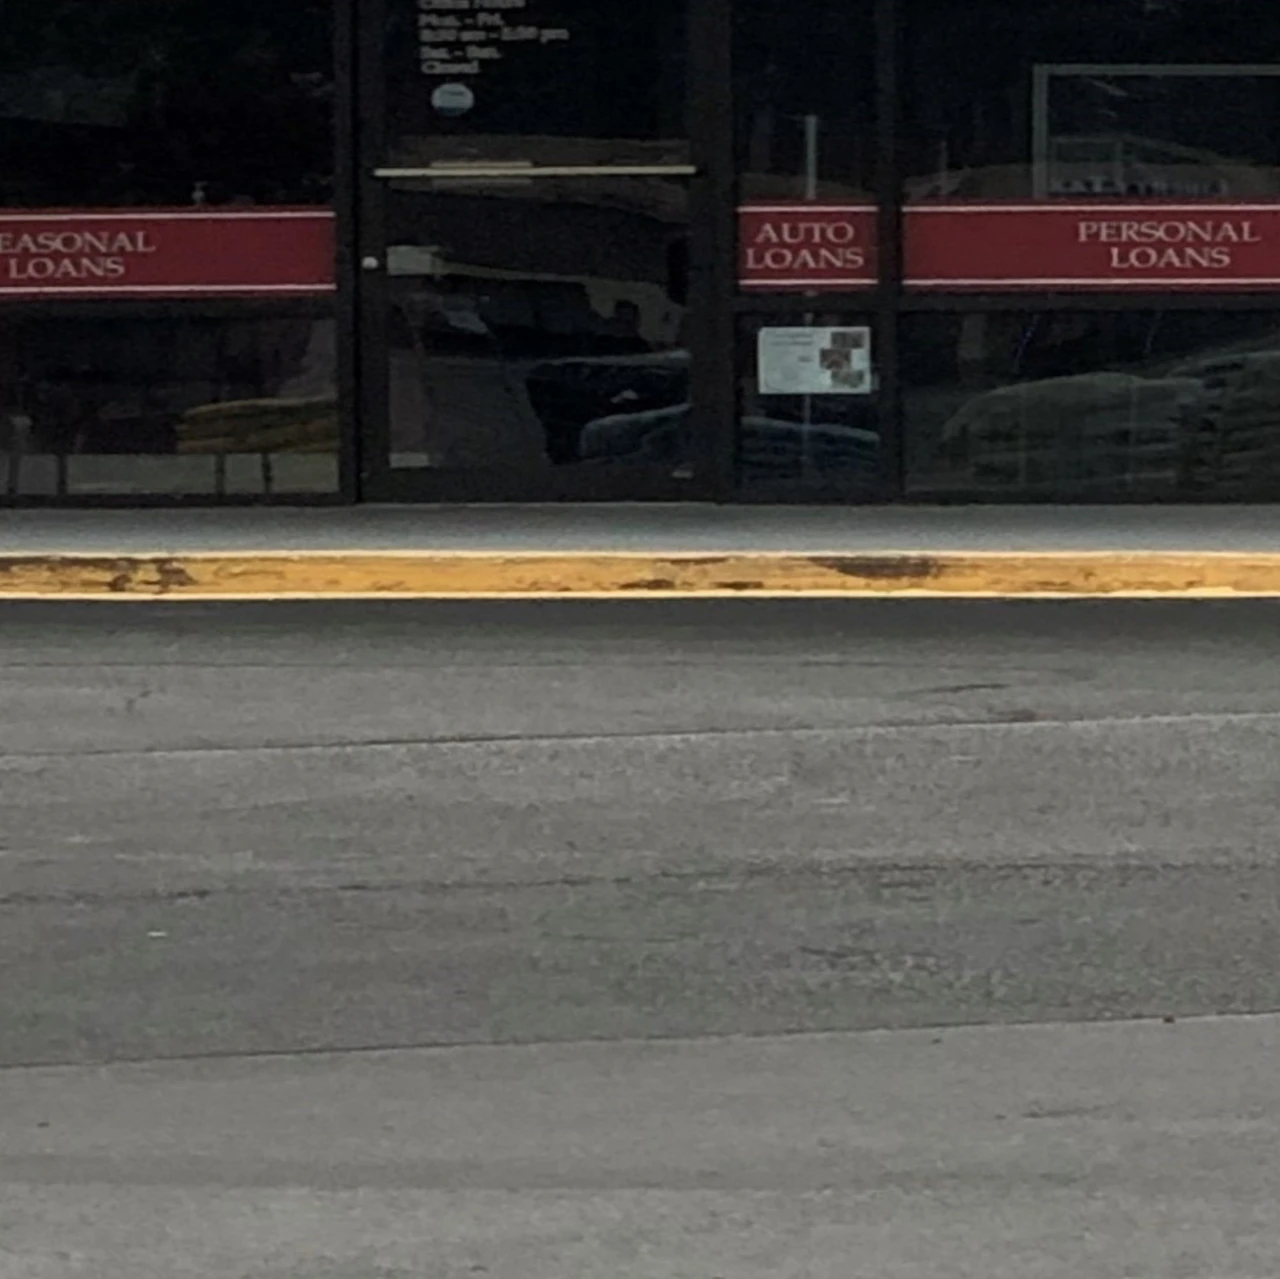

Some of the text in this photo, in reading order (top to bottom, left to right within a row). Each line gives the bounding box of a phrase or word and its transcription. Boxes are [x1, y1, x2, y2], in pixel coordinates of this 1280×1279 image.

[755, 222, 855, 243] AUTO
[1077, 220, 1261, 243] PERSONAL
[8, 257, 126, 279] LOANS
[746, 247, 865, 269] LOANS
[1110, 247, 1231, 268] LOANS
